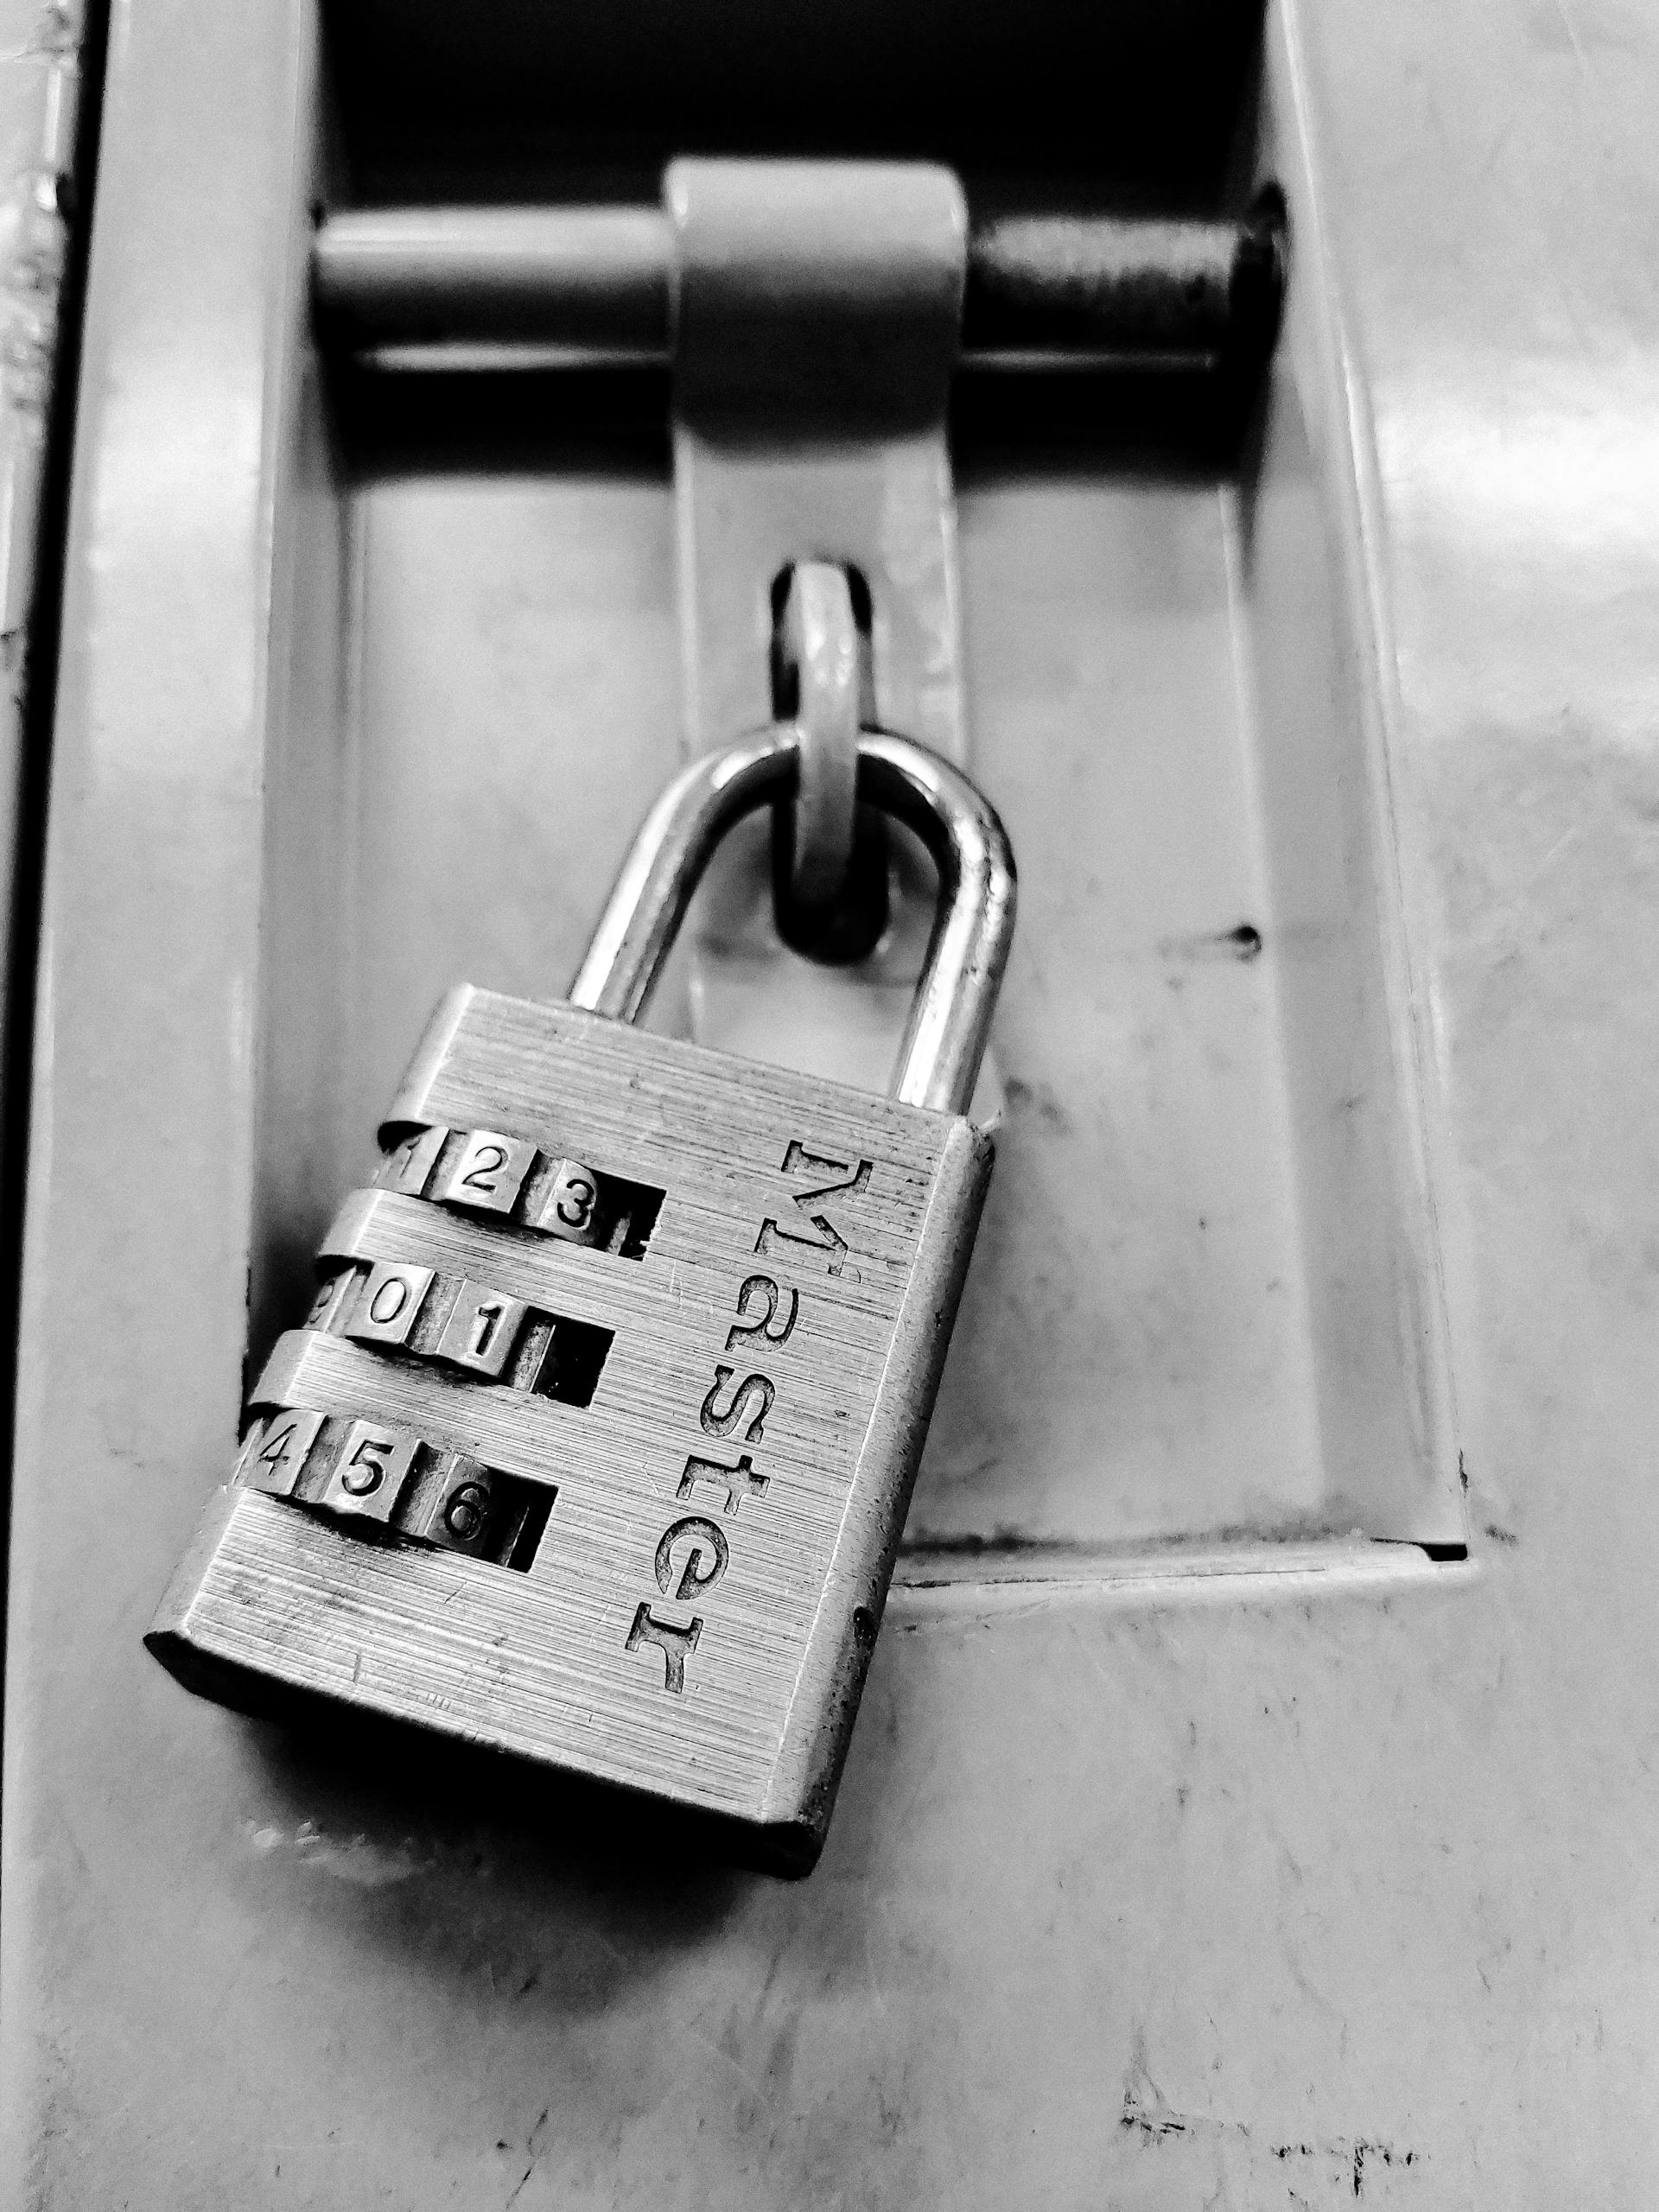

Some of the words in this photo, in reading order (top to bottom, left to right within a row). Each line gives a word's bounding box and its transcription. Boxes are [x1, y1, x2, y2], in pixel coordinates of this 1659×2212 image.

[463, 1146, 508, 1192] 2
[556, 1178, 596, 1229] 3
[370, 1277, 410, 1325] 0
[469, 1303, 503, 1358] 1
[625, 1140, 874, 1694] Master
[259, 1423, 298, 1476] 4
[341, 1440, 395, 1497] 5
[445, 1482, 491, 1540] 6
